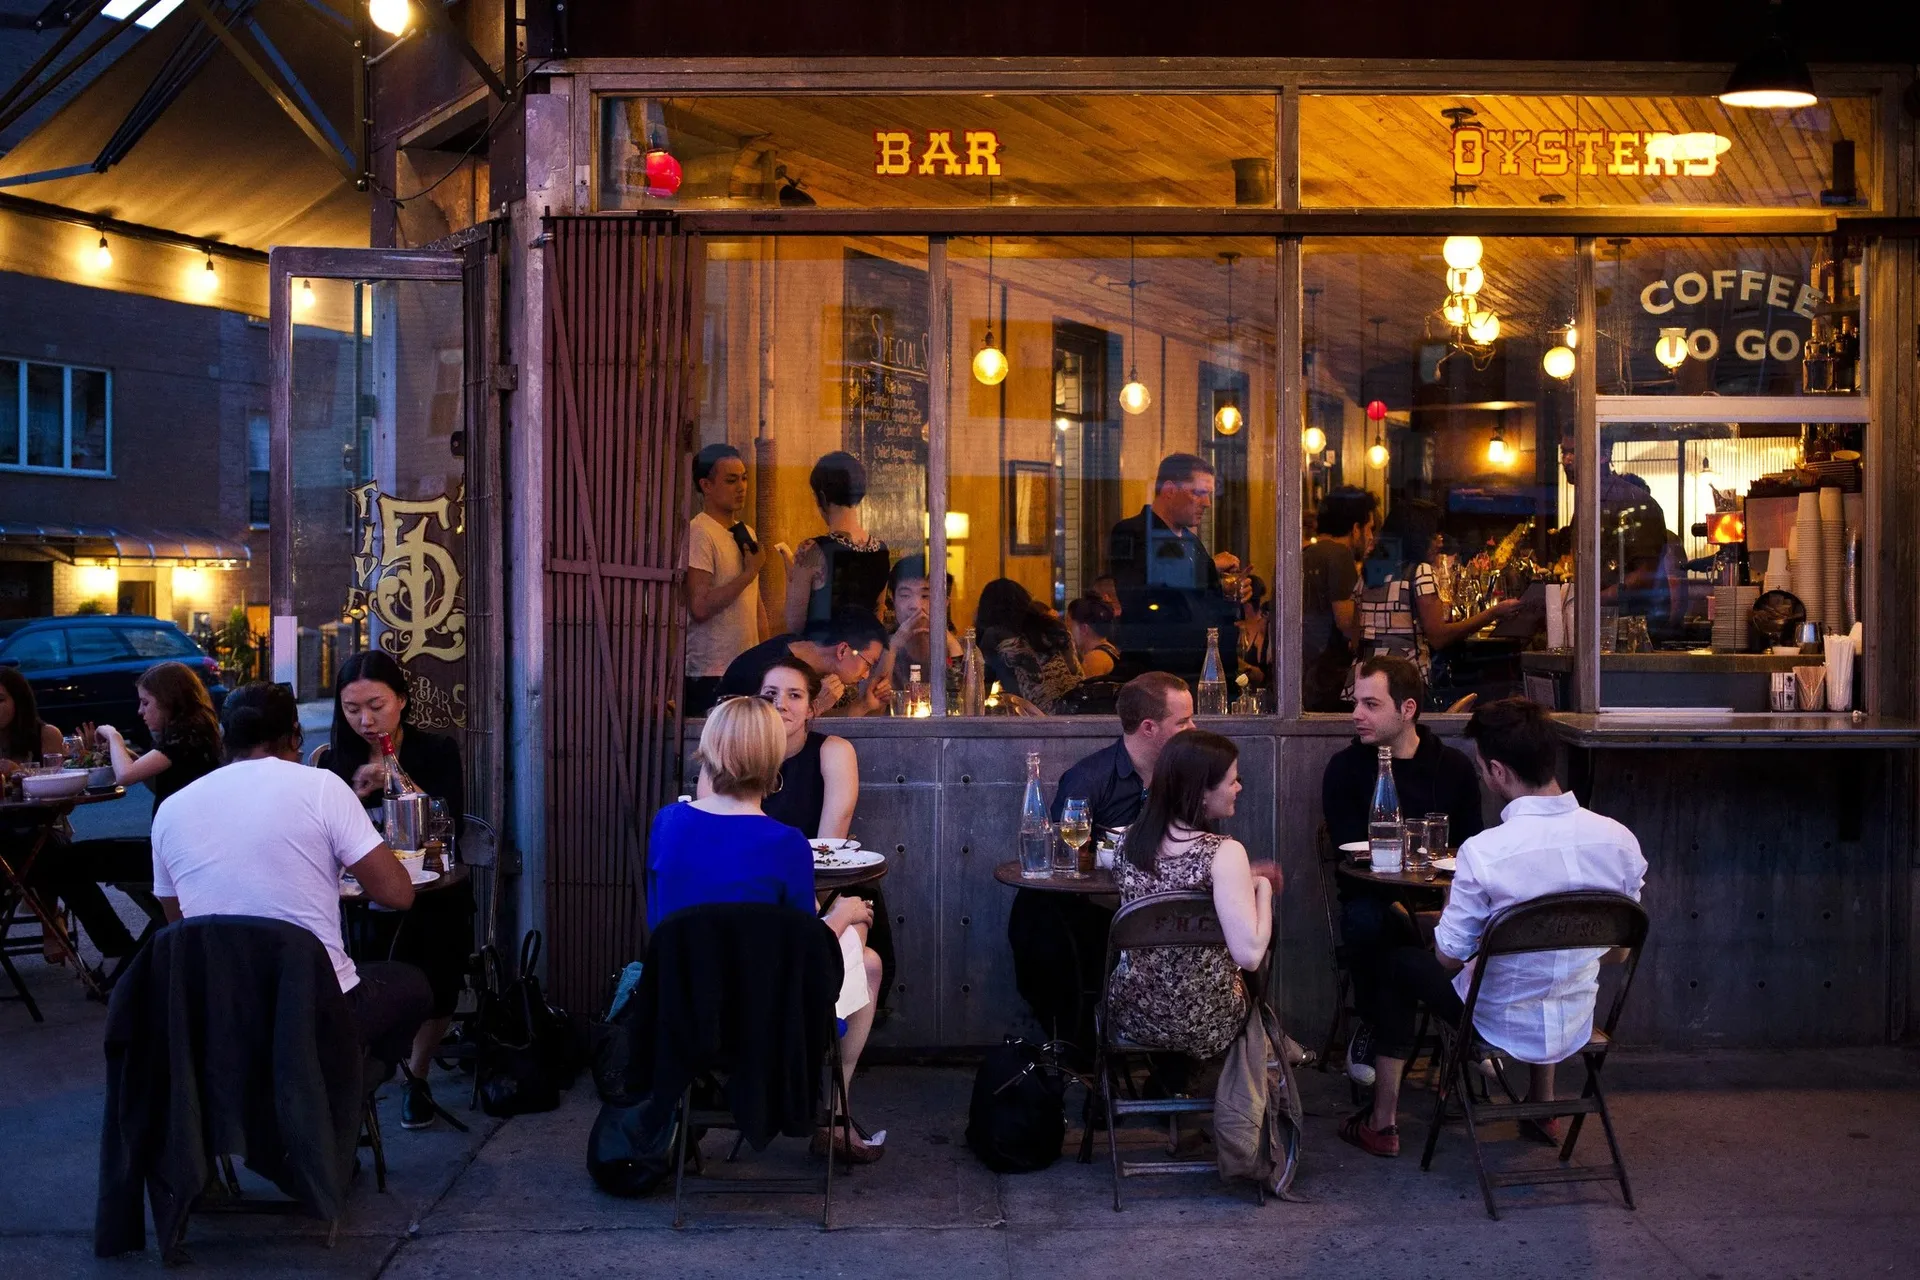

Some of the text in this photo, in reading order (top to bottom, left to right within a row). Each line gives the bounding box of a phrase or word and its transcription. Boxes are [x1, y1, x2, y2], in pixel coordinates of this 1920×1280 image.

[874, 129, 1001, 176] BAR
[1451, 128, 1721, 177] OYSTERS
[1640, 269, 1824, 320] COFFEE
[869, 313, 930, 372] SPECIALS
[1659, 327, 1801, 361] TO GO
[343, 479, 379, 621] FIVE
